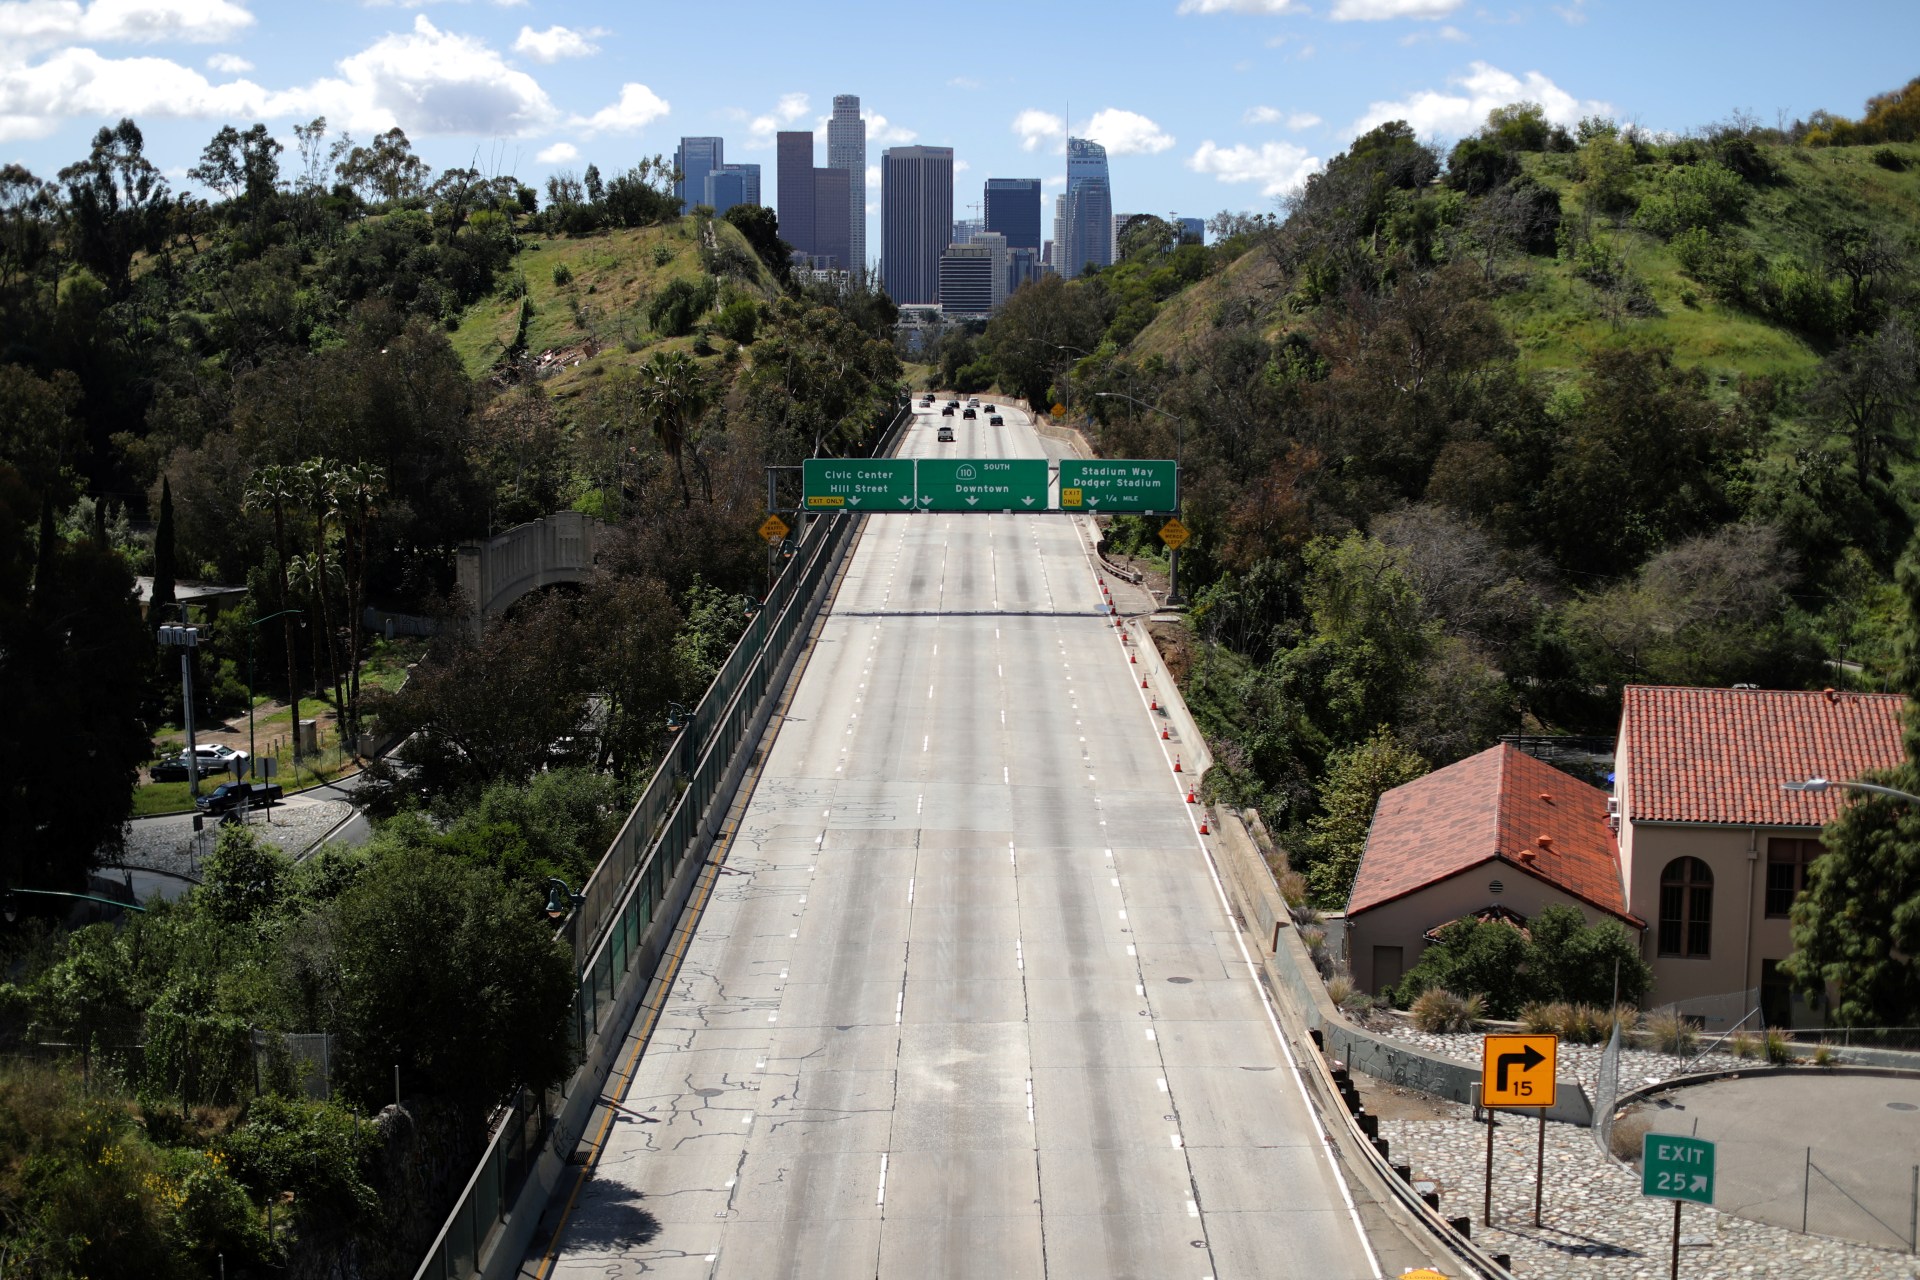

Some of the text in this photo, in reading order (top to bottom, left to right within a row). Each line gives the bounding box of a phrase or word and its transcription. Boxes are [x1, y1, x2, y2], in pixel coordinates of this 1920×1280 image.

[825, 471, 893, 479] Civic Center
[1082, 467, 1154, 477] Stadium Way
[831, 484, 888, 492] Hill Street
[1074, 478, 1160, 488] Dodger Stadium
[1514, 1081, 1533, 1096] 15
[1658, 1144, 1704, 1164] EXIT
[1657, 1172, 1686, 1191] 25
